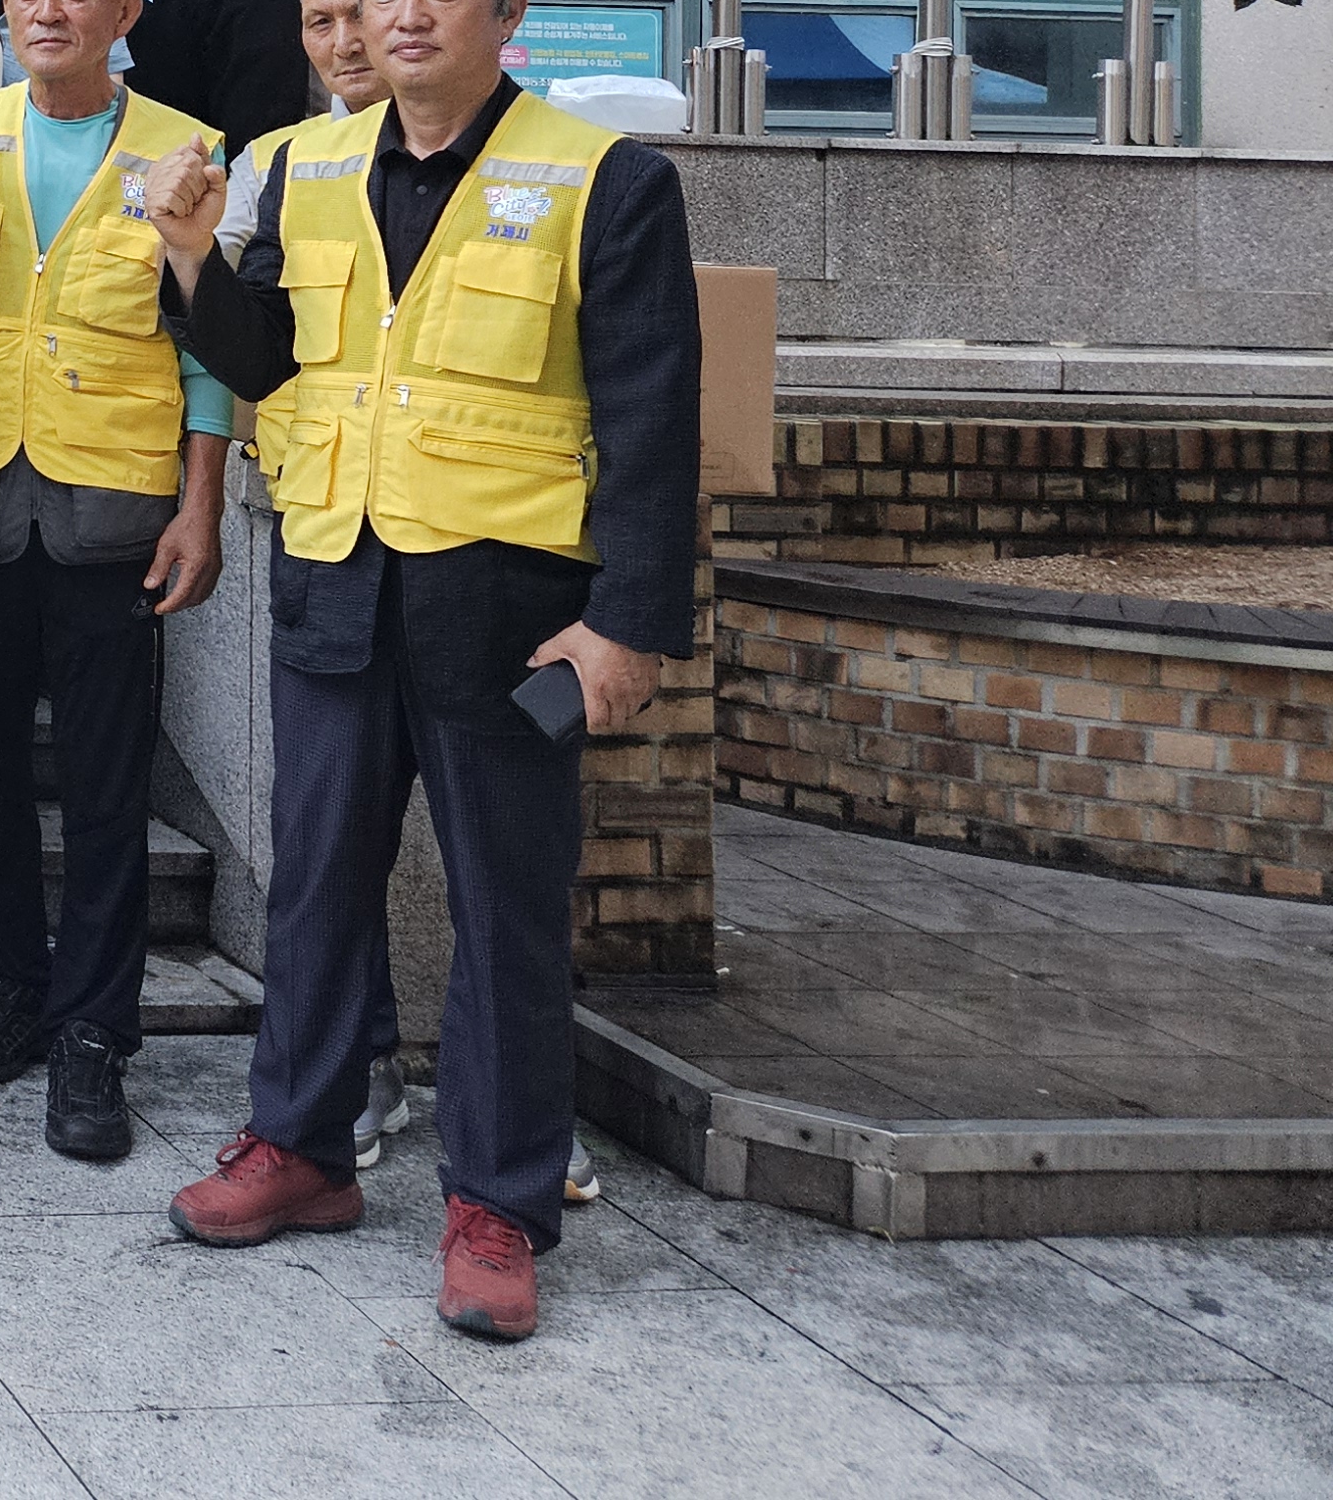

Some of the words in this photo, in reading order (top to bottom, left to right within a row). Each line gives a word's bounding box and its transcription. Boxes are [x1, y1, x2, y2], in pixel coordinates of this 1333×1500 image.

[484, 184, 532, 204] Blue
[491, 197, 527, 218] City
[486, 224, 530, 241] 거제시
